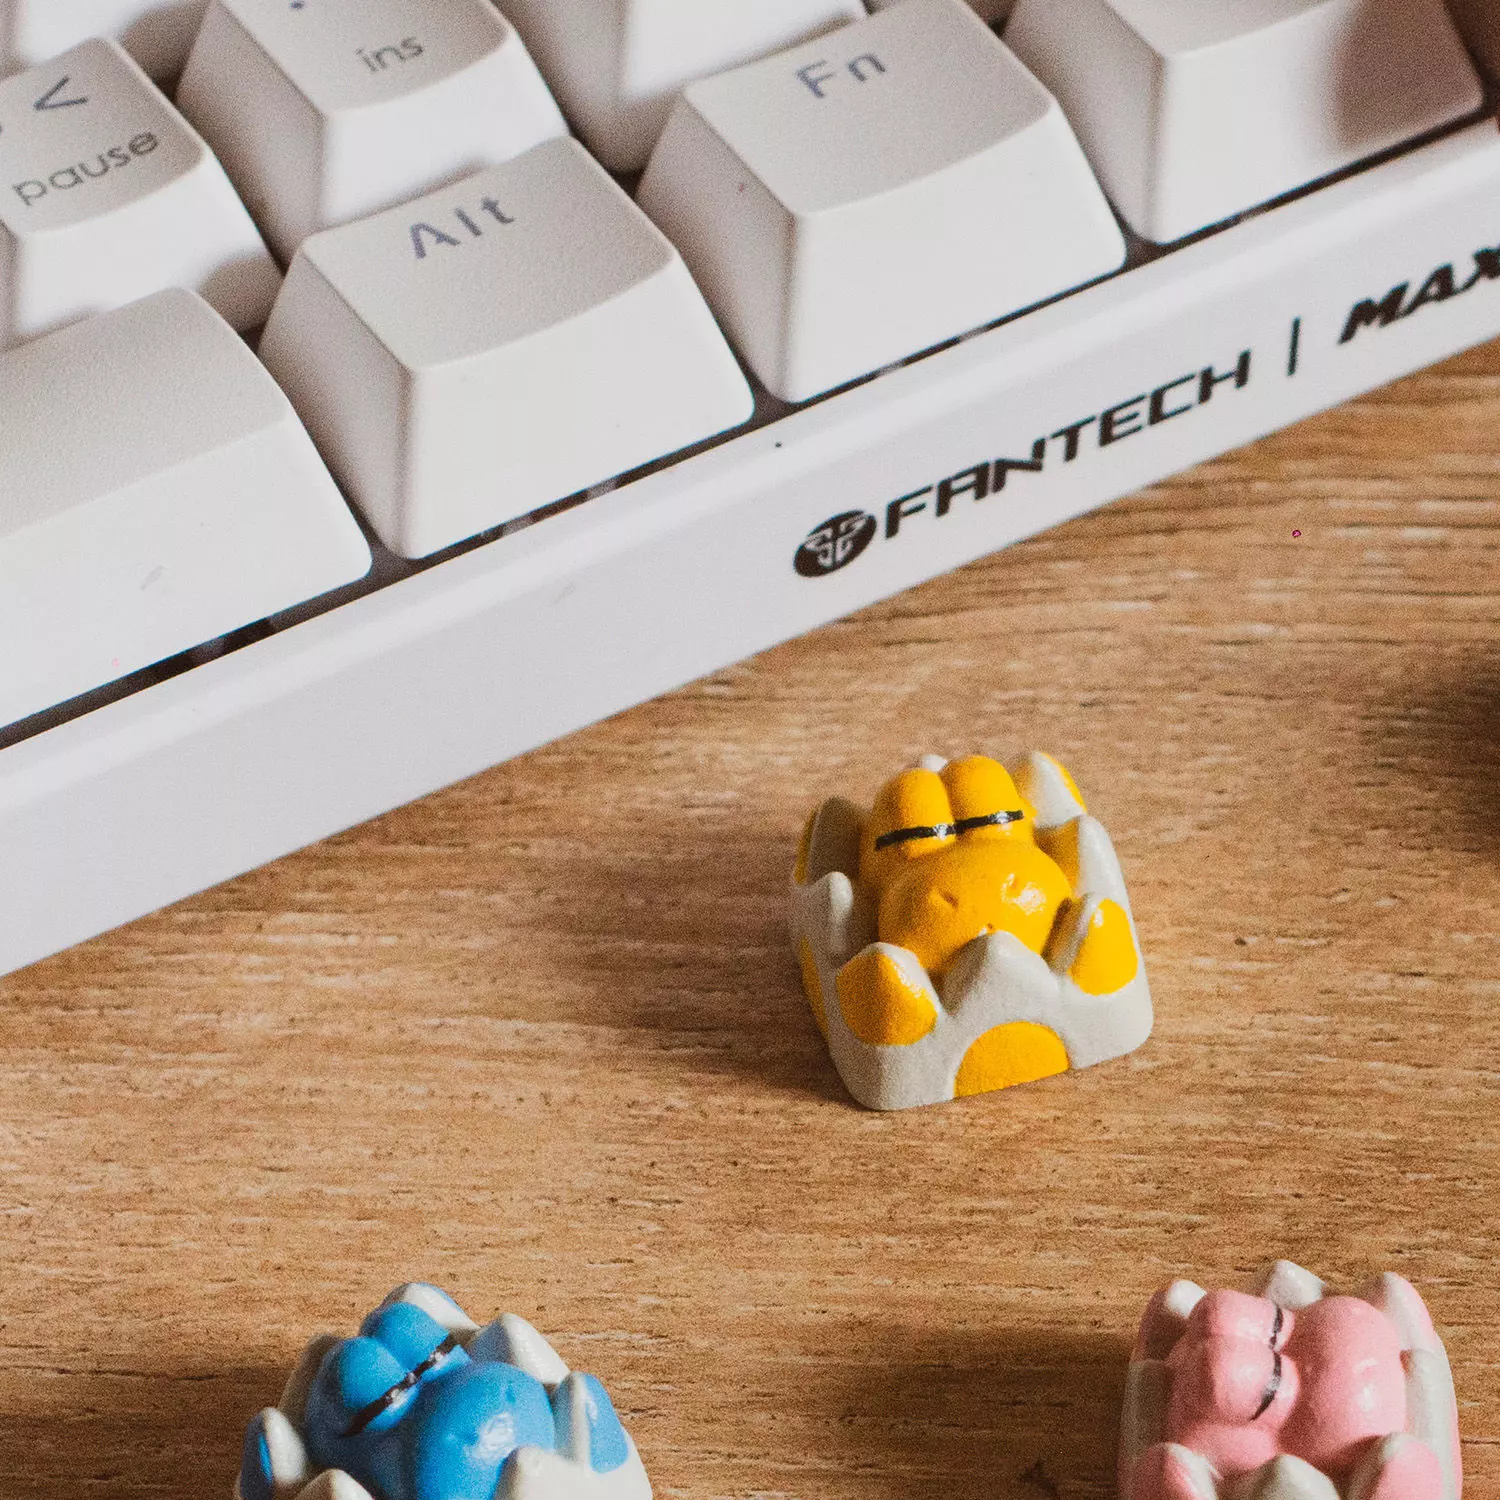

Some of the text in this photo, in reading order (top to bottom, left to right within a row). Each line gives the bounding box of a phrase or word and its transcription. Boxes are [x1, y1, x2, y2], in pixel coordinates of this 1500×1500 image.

[355, 36, 424, 72] ins
[794, 50, 888, 99] Fn
[13, 131, 160, 206] pause
[409, 196, 515, 259] Alt
[885, 349, 1250, 539] FANTECH
